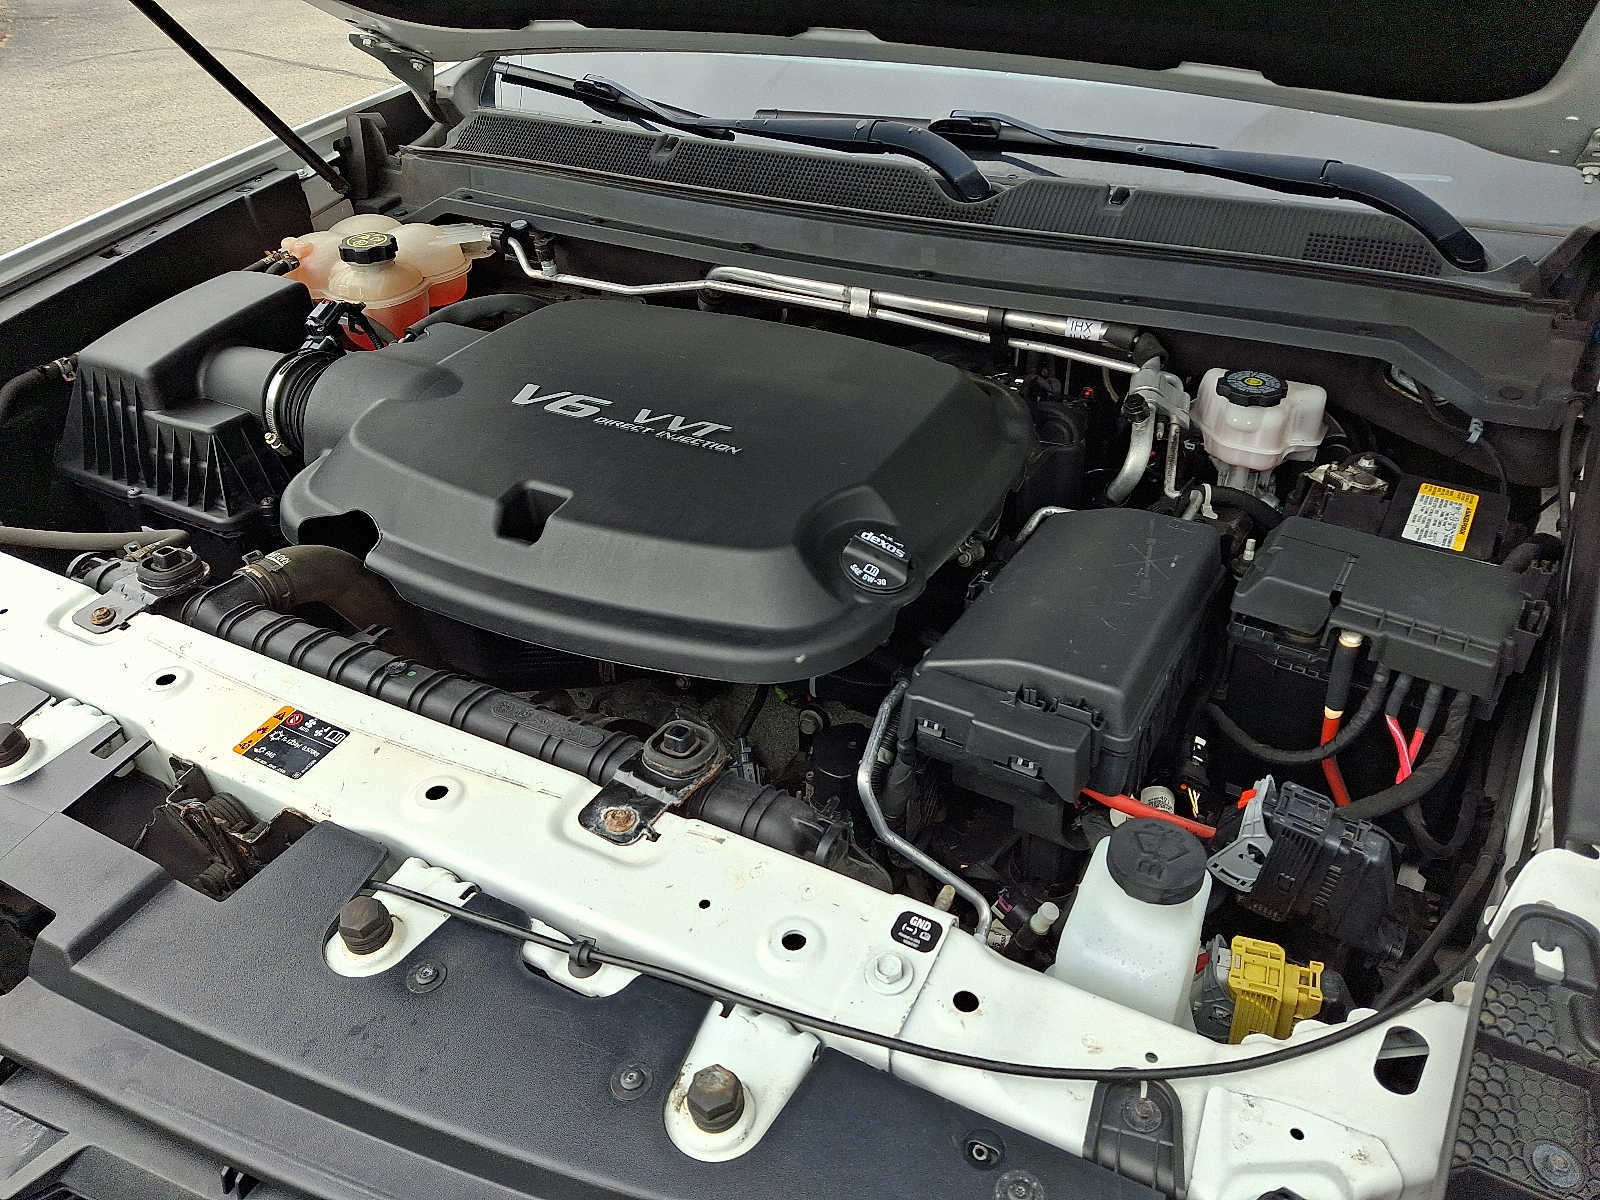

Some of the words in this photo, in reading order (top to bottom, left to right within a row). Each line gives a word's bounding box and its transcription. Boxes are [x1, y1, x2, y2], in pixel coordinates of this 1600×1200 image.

[511, 383, 615, 418] V6
[633, 408, 733, 437] VVT
[593, 416, 655, 435] DIRECT
[655, 430, 743, 456] INJECTION
[861, 531, 906, 558] dexos
[850, 563, 864, 576] SAE
[862, 573, 887, 586] 5W-30
[909, 915, 932, 931] GND
